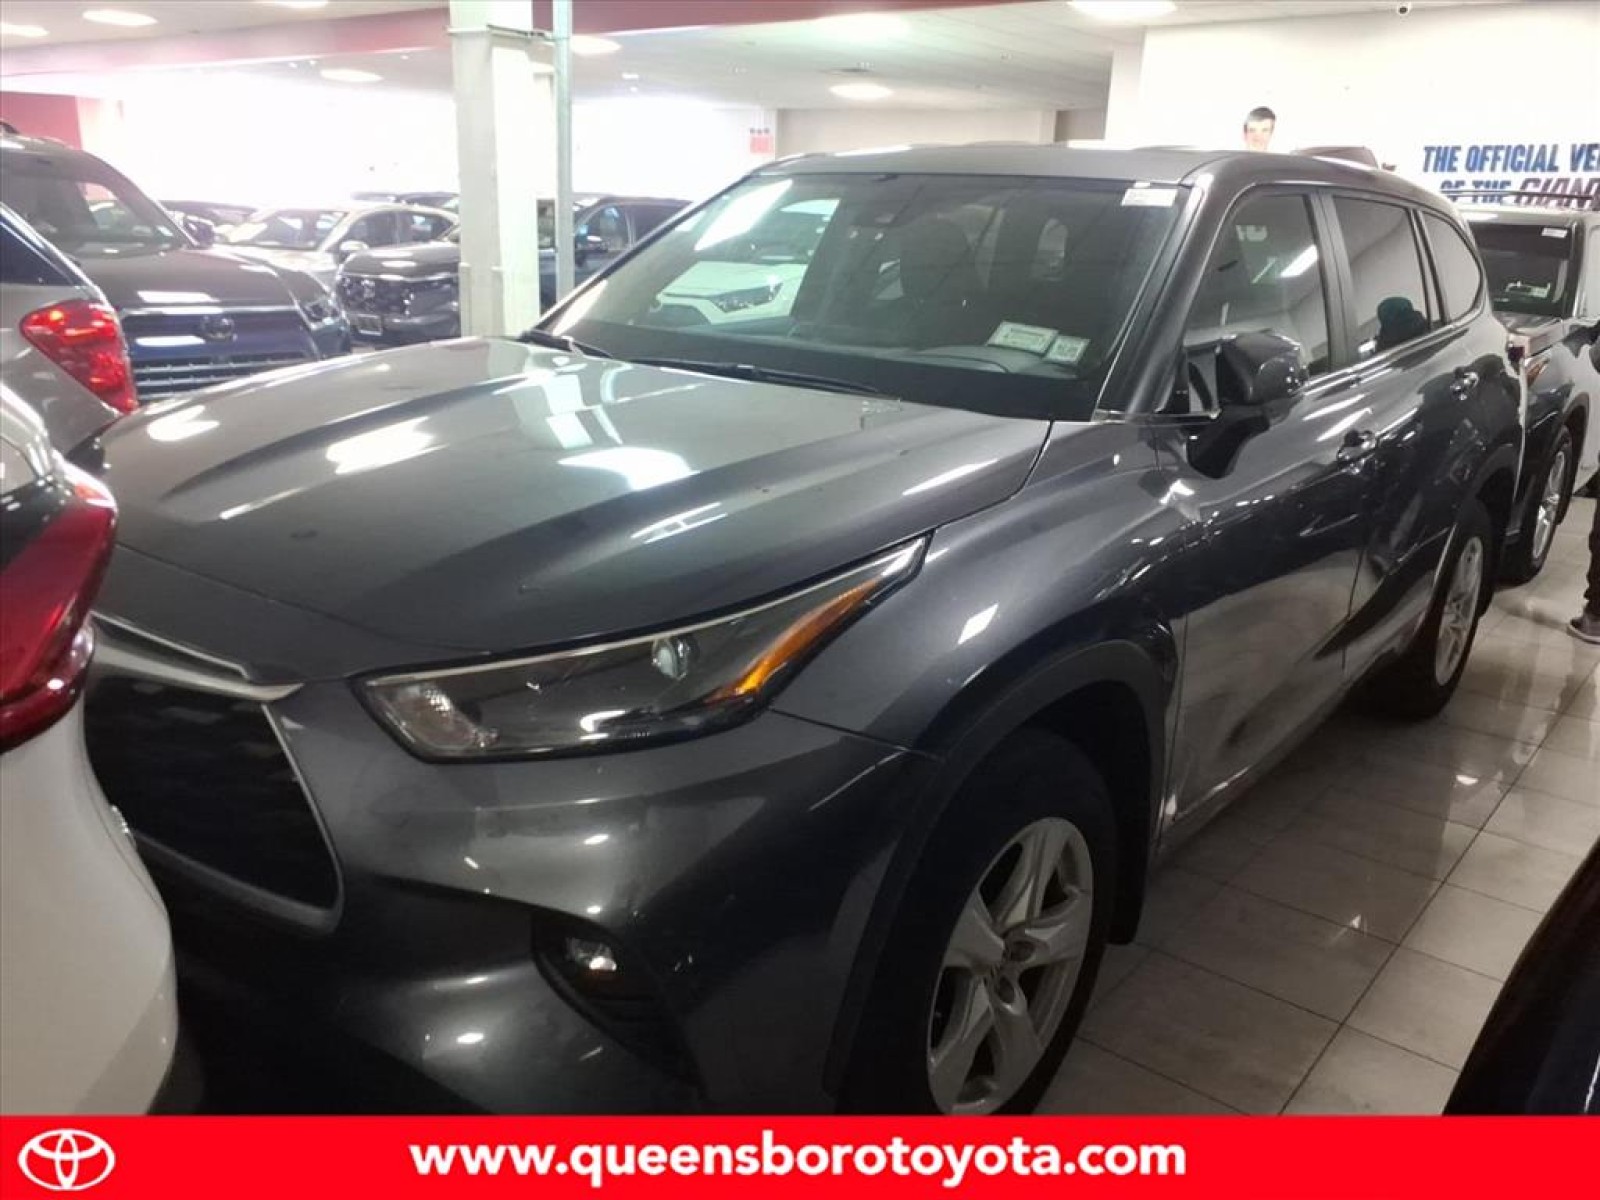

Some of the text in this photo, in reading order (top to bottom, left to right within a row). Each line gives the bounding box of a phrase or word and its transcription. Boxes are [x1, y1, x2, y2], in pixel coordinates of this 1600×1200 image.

[1423, 143, 1600, 172] THE OFFICIAL VE
[1471, 180, 1511, 203] THE
